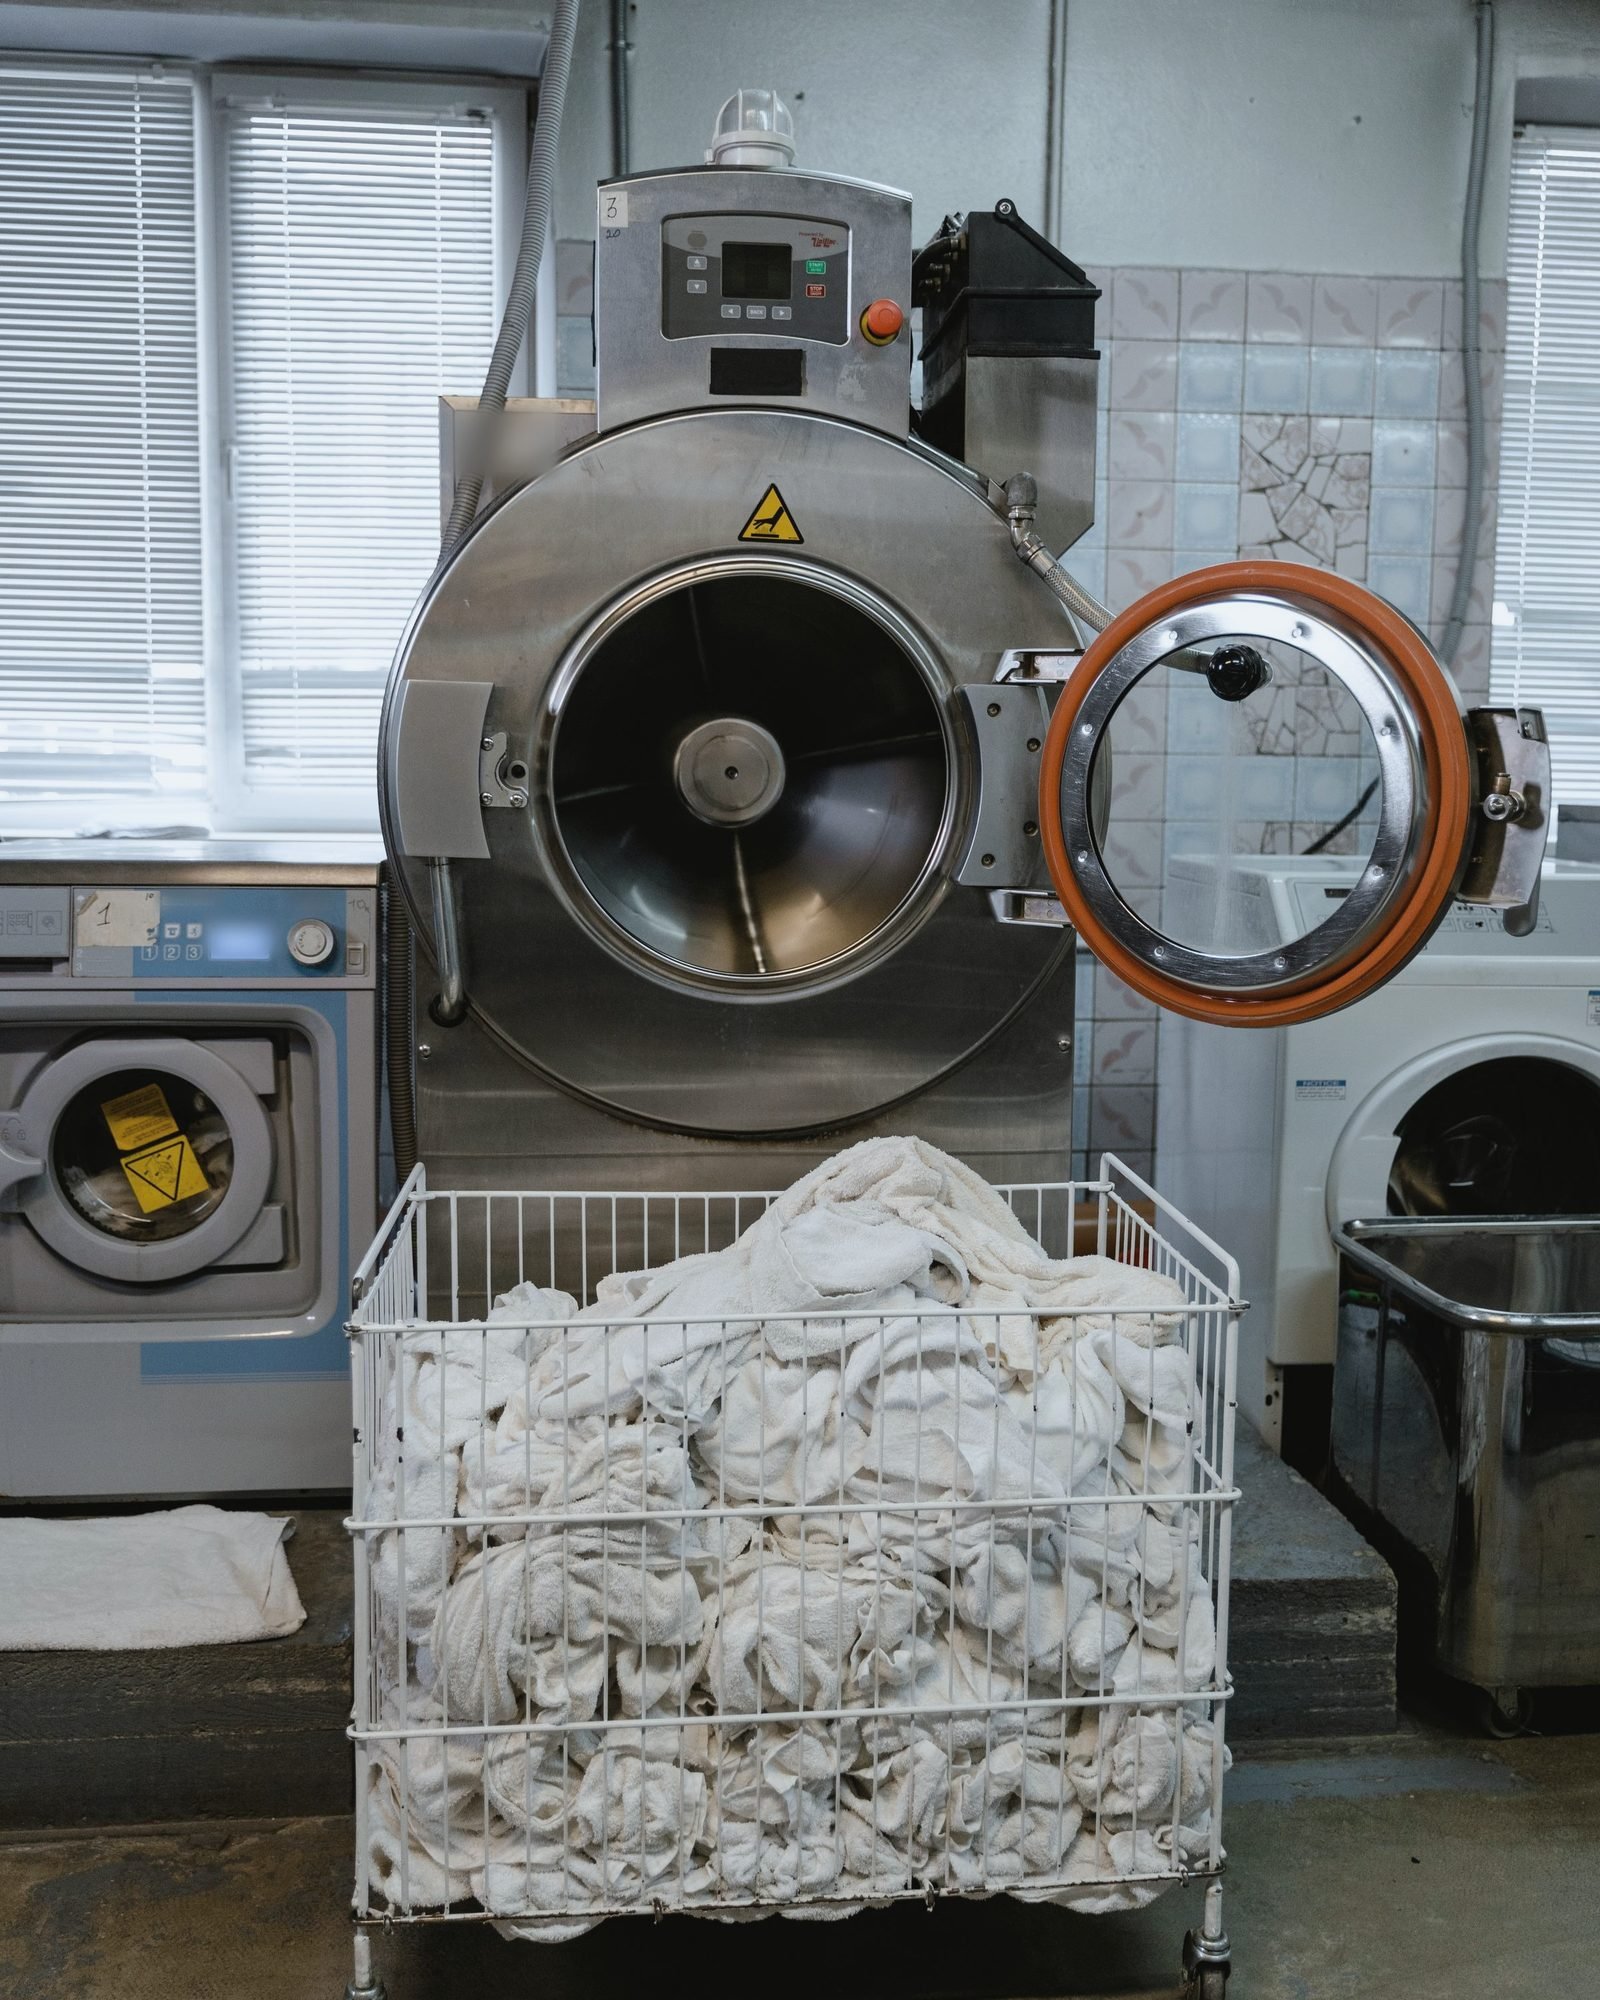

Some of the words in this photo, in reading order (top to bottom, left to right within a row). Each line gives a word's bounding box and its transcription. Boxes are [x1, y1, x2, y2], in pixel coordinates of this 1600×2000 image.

[606, 197, 618, 218] 3
[606, 228, 621, 239] 20
[97, 902, 111, 927] 1
[146, 947, 152, 958] 1
[167, 947, 176, 958] 2
[189, 947, 198, 958] 3
